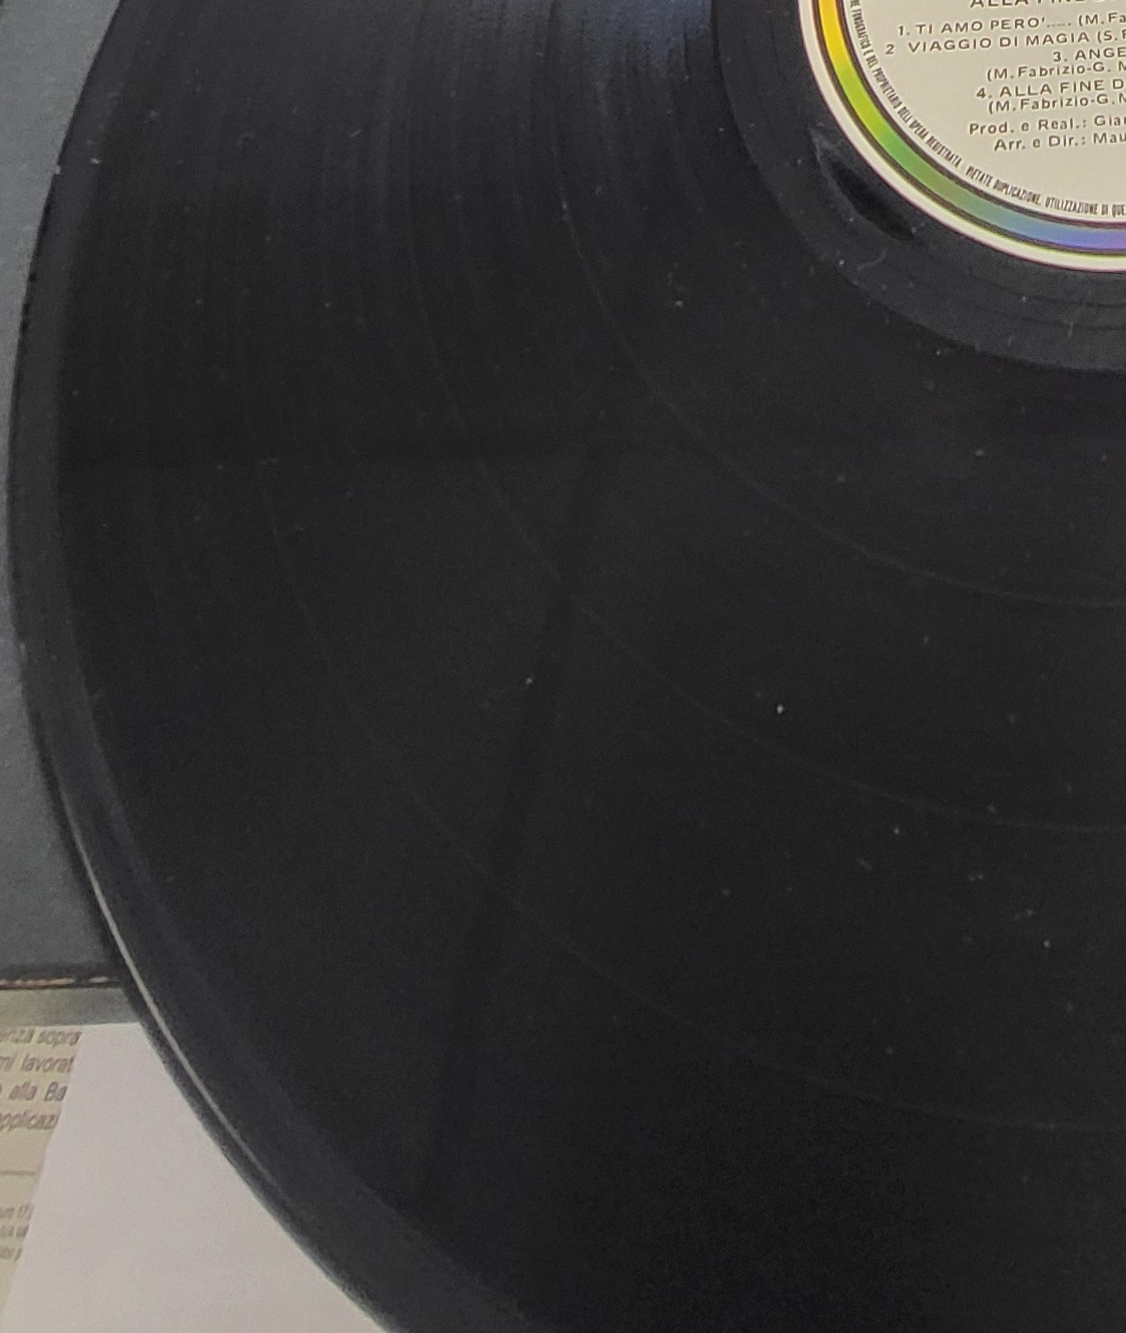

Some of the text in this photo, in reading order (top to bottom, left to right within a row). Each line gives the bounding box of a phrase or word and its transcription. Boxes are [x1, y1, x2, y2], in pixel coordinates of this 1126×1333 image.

[898, 25, 910, 36] 1.
[916, 23, 933, 35] TI
[941, 20, 983, 33] AMO
[885, 44, 895, 55] 2
[908, 37, 992, 53] VIAGGIO
[1000, 36, 1018, 48] DI
[1026, 31, 1090, 46] MAGIA
[1053, 51, 1068, 63] 3.
[976, 87, 992, 100] 4.
[1000, 83, 1052, 98] ALLA
[1060, 79, 1105, 94] FINE
[969, 120, 1014, 136] Prod.
[1021, 122, 1029, 132] e
[994, 137, 1026, 151] Arr.
[1032, 138, 1040, 149] e
